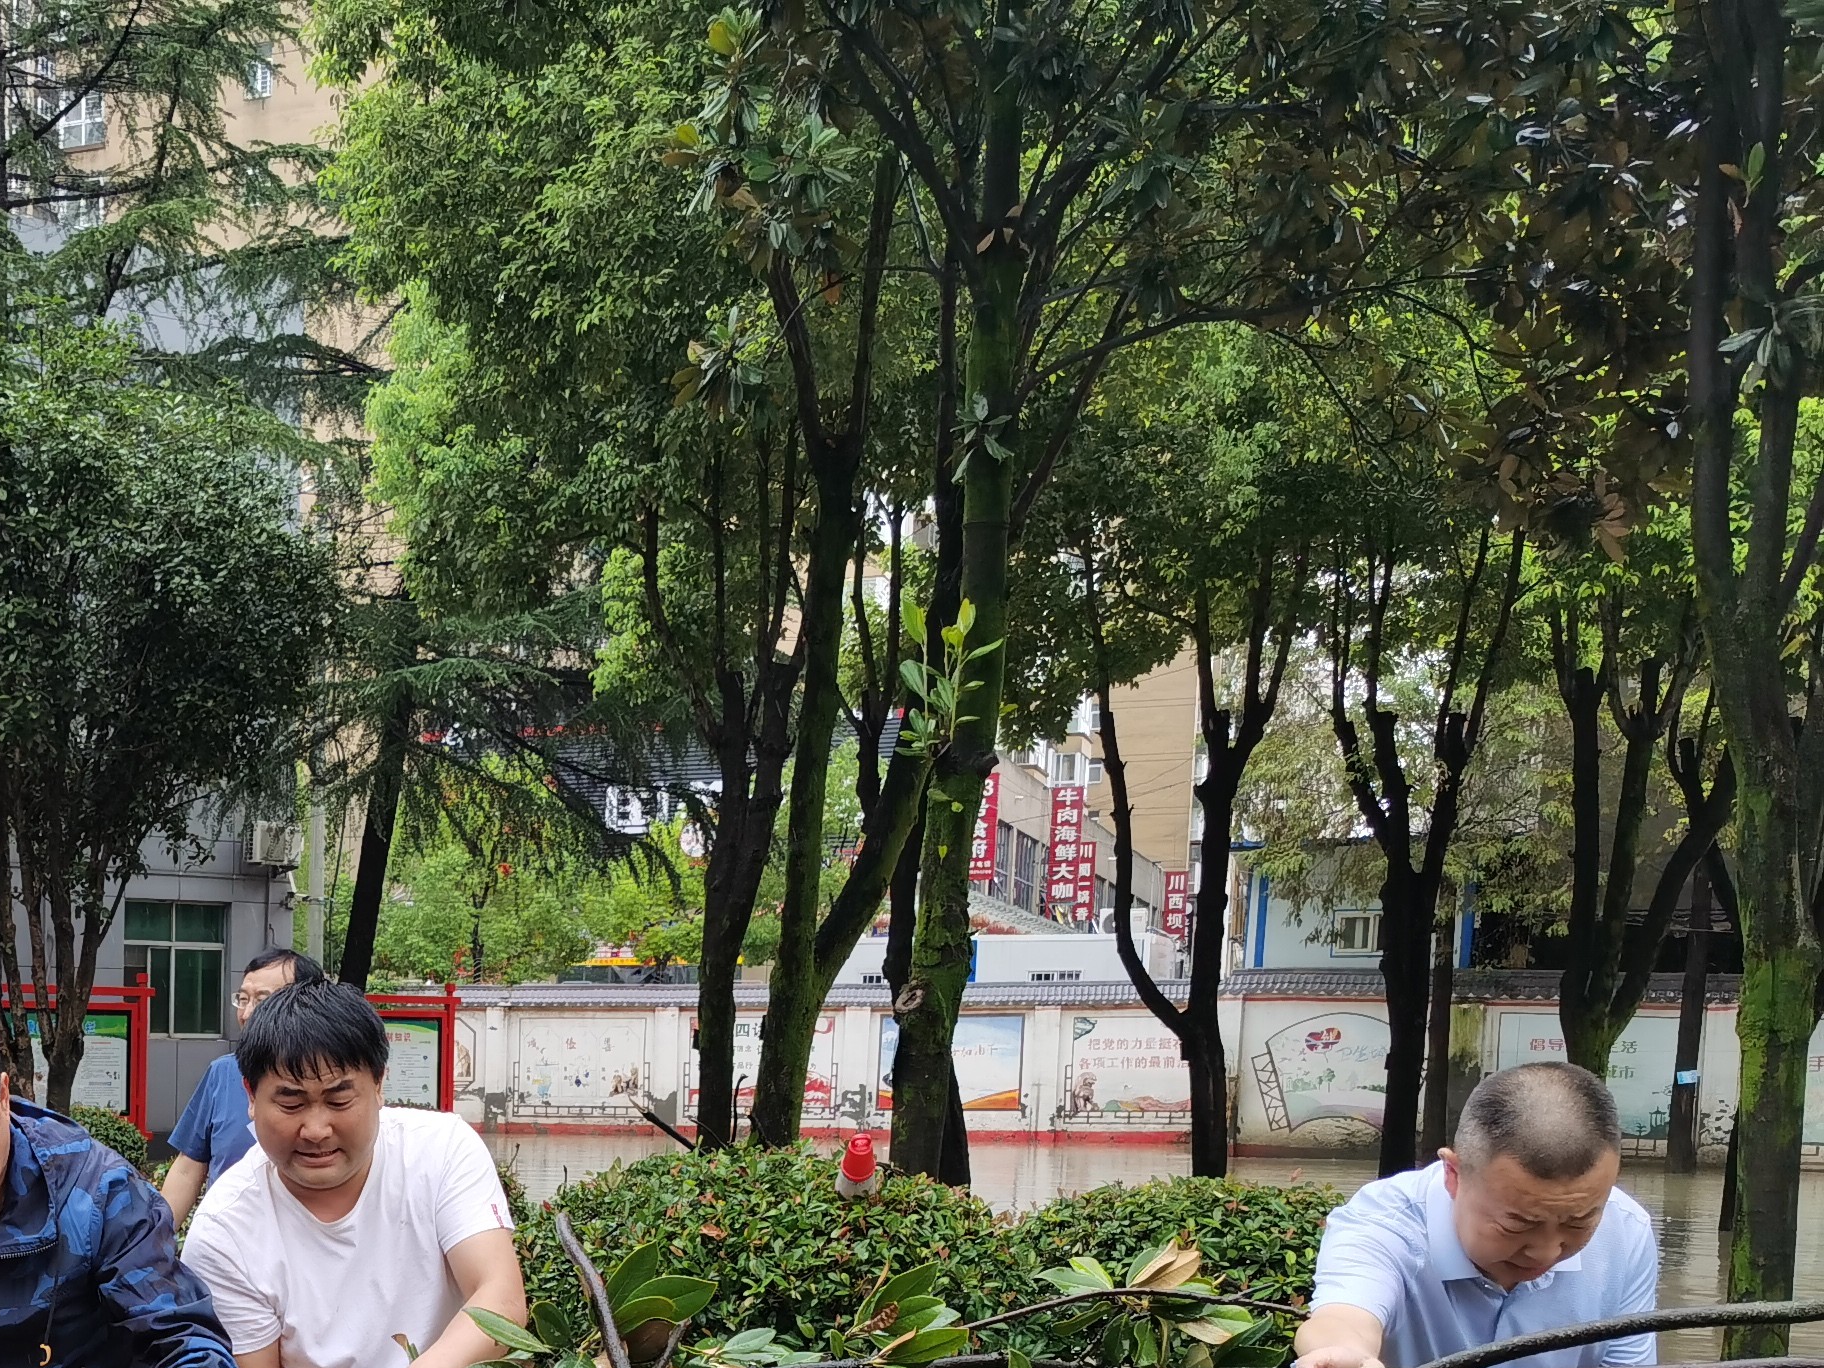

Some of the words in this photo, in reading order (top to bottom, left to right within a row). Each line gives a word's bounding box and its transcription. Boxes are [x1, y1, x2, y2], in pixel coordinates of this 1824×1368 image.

[1051, 789, 1079, 899] 牛肉海鲜大咖
[1166, 874, 1185, 937] 川西坝
